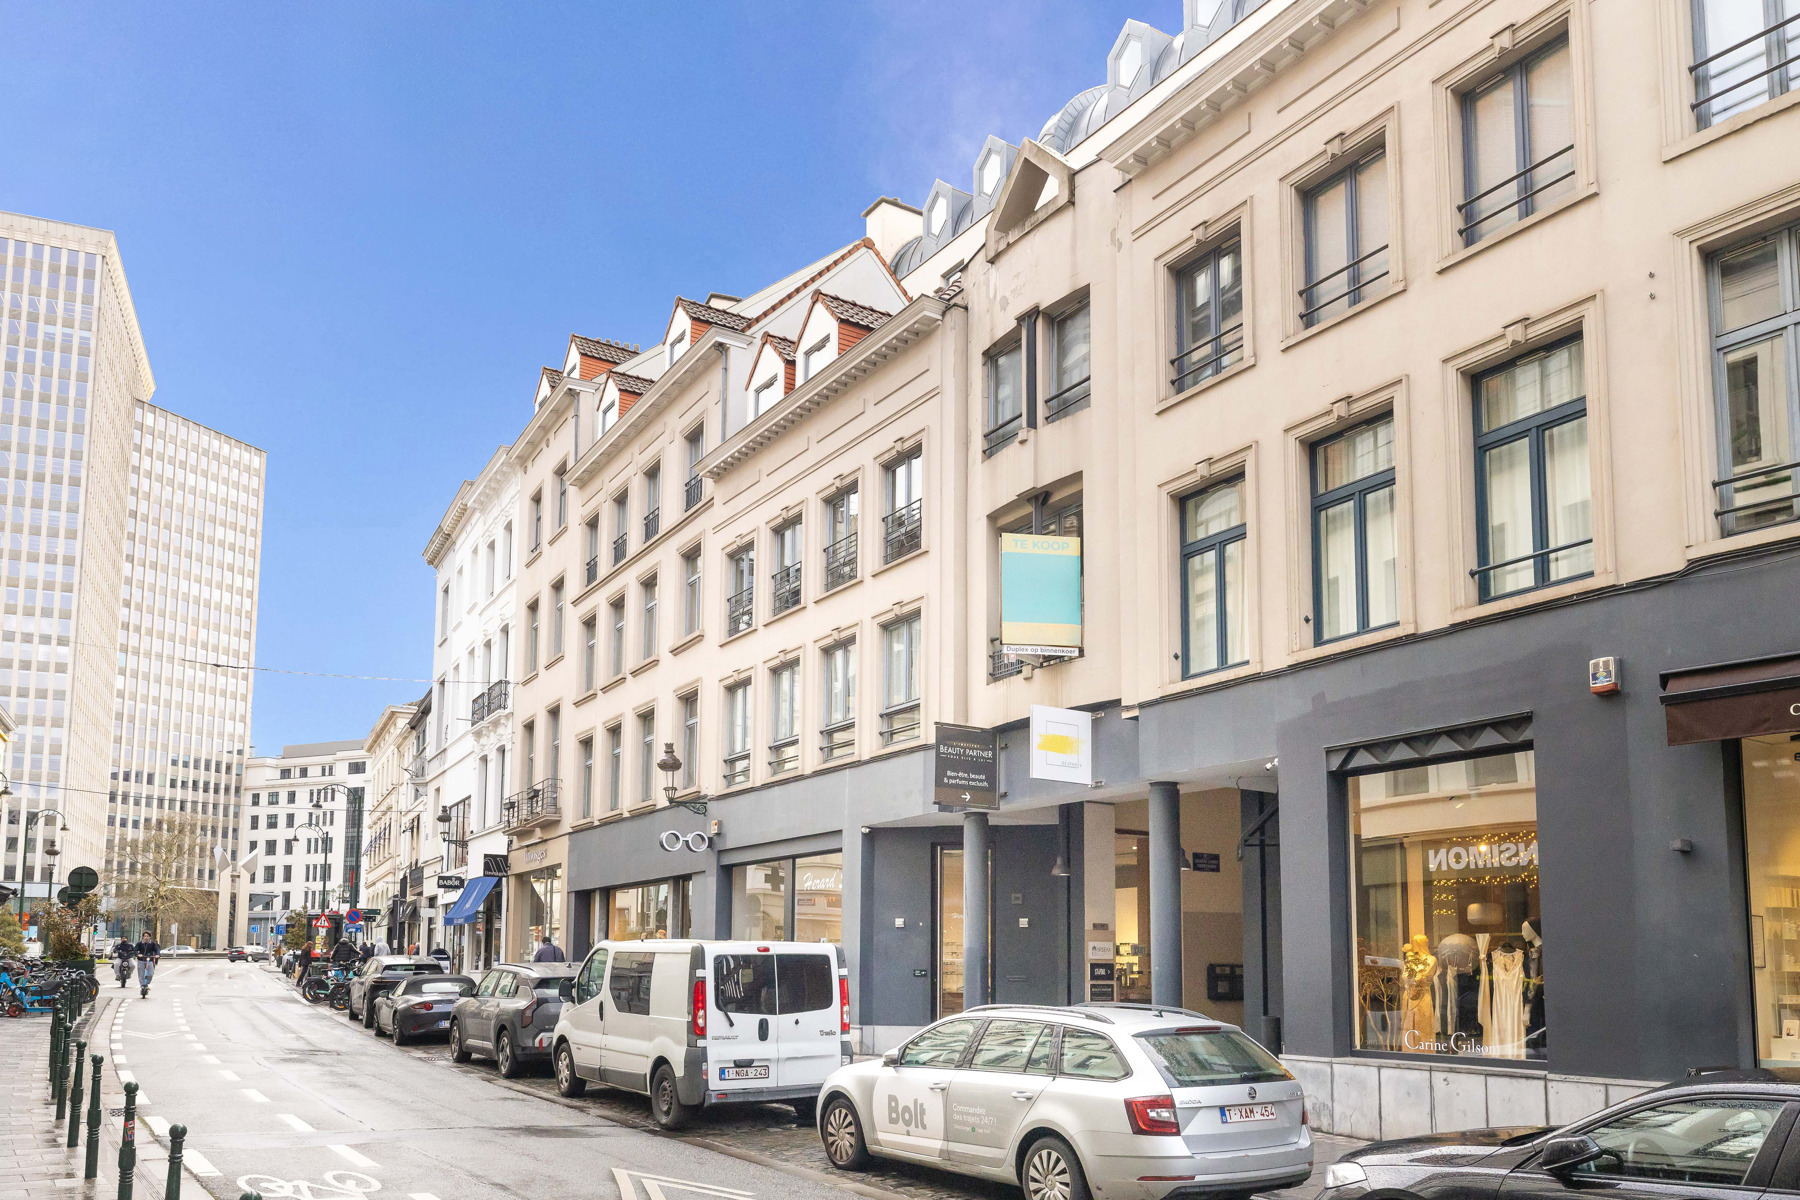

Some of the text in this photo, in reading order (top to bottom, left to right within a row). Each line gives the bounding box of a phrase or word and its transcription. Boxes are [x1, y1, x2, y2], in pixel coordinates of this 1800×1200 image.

[1013, 539, 1070, 551] TE KOOP
[1006, 645, 1029, 653] Duplex
[1040, 647, 1077, 655] binnenkoer
[940, 745, 993, 758] BEAUTY PARTNER
[946, 770, 986, 780] Bien-être, beauté
[949, 778, 969, 786] parfums
[969, 780, 989, 788] exclusifs
[438, 878, 461, 887] BABOR
[1404, 1029, 1448, 1051] Carine
[1451, 1031, 1496, 1054] Gilson
[888, 1094, 927, 1133] Bolt
[952, 1103, 986, 1115] Commandez
[952, 1113, 962, 1121] des
[963, 1114, 980, 1123] trajets
